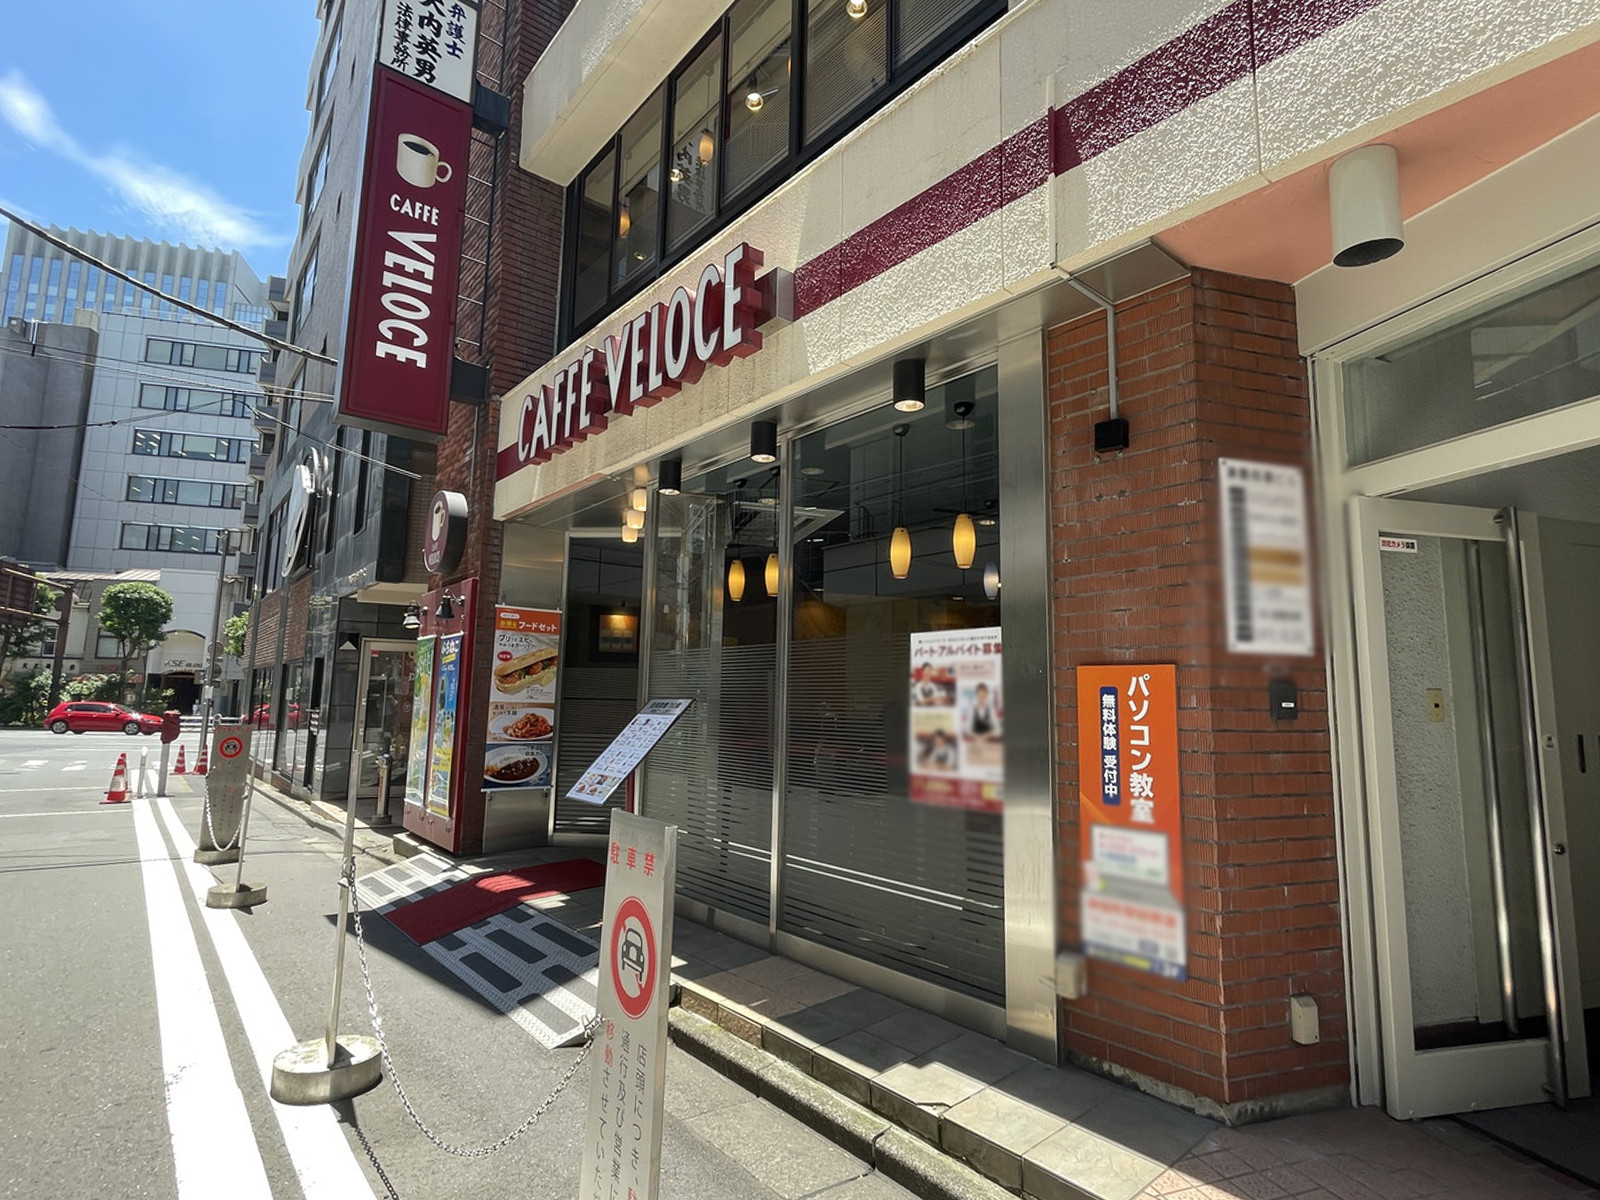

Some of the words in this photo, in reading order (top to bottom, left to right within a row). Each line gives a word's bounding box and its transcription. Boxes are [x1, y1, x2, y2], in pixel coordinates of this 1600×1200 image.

[390, 1, 414, 72] 法律事務所
[445, 3, 467, 60] 弁護士
[375, 231, 438, 369] VELOCE
[604, 242, 752, 416] VELOCE
[518, 620, 558, 632] フードセット
[1101, 694, 1118, 751] 無料体験
[1126, 672, 1156, 824] パソコン教室
[1103, 754, 1119, 798] 受付中
